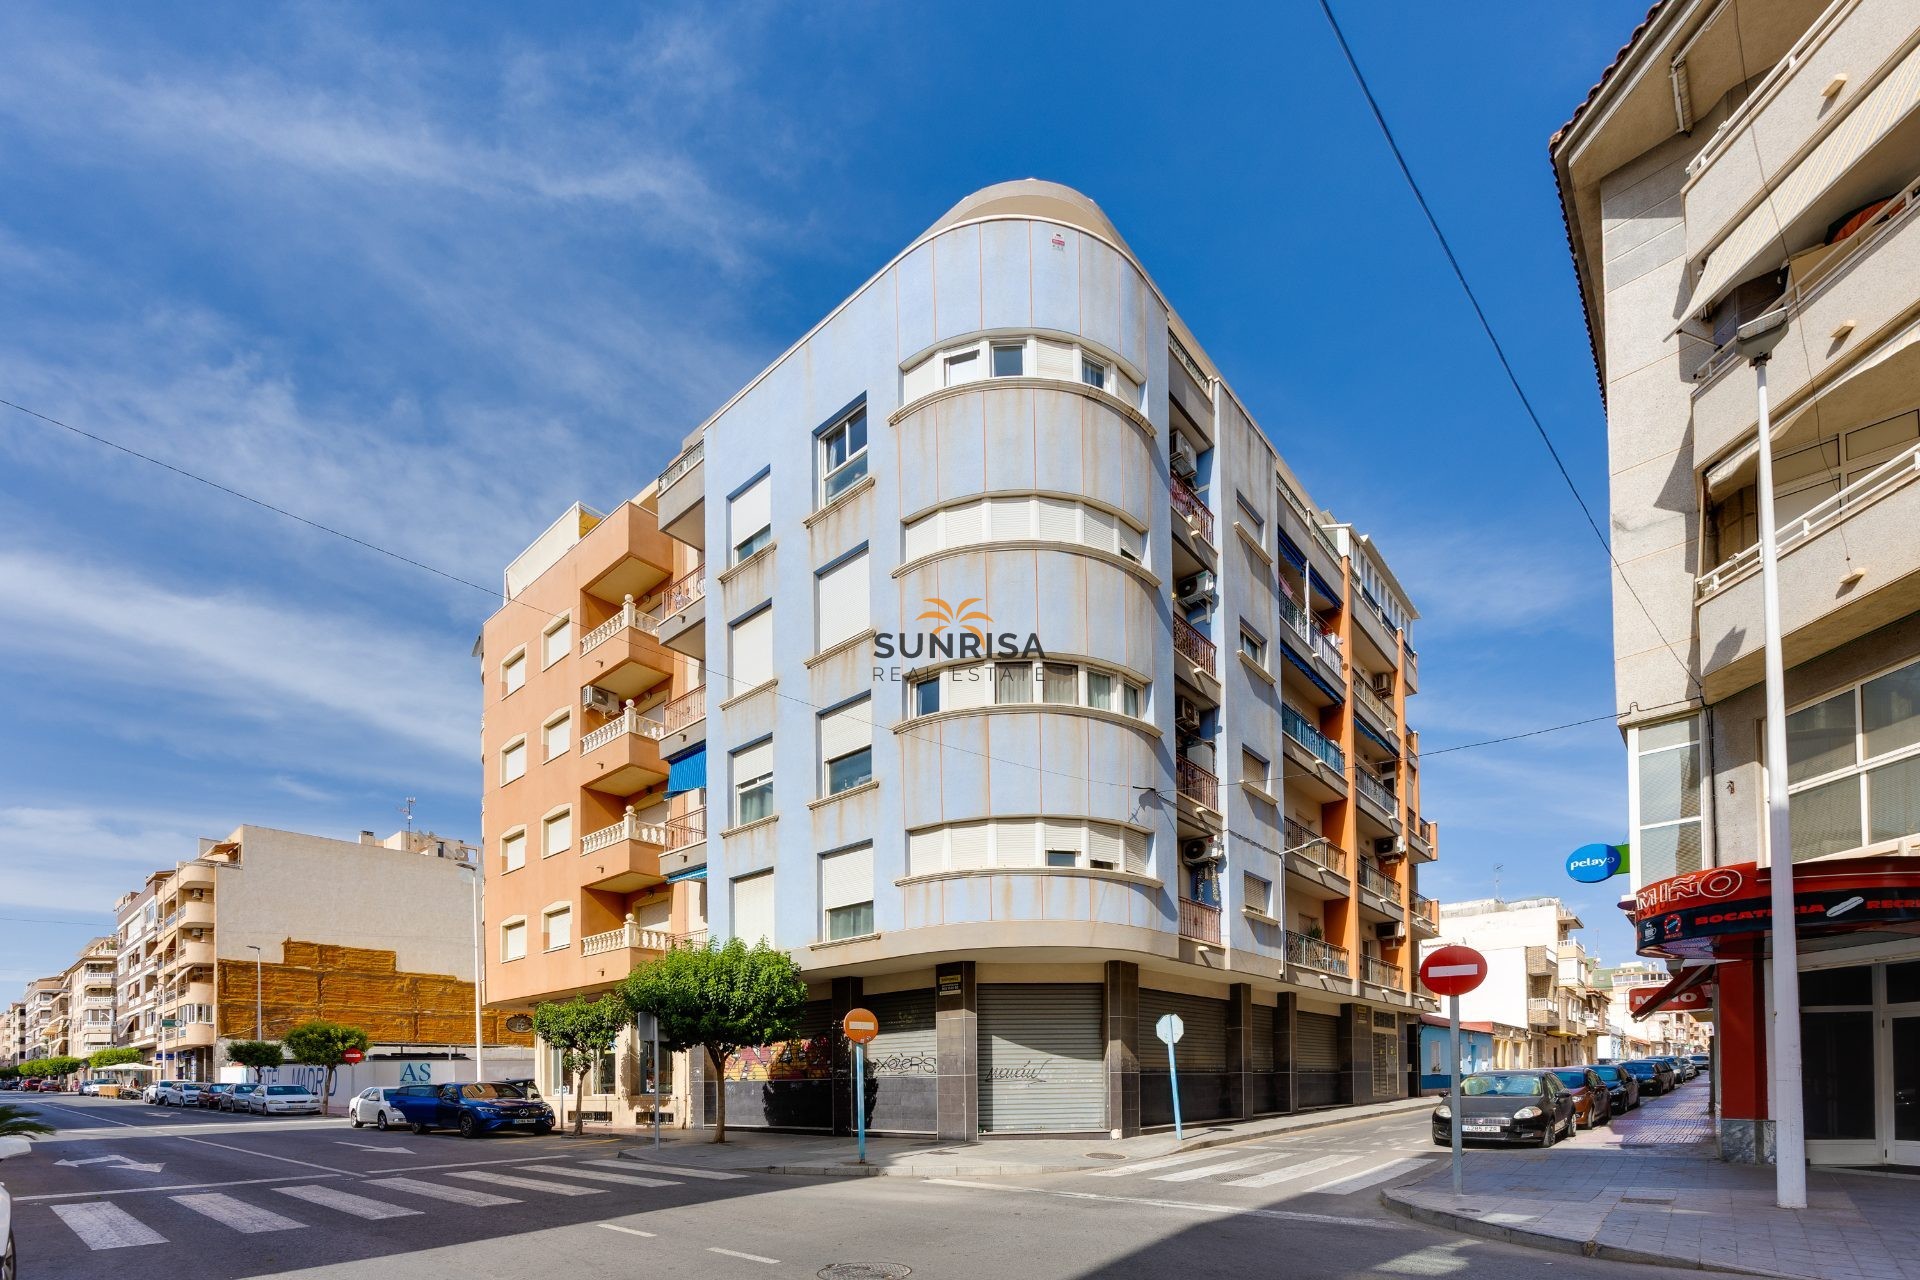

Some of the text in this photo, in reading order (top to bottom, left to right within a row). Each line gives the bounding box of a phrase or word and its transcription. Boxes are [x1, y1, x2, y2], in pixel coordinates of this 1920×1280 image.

[1570, 856, 1615, 871] pelayo
[1636, 868, 1743, 910] MIÑO
[1695, 903, 1825, 926] BOCATIA
[1635, 992, 1698, 1005] MO
[399, 1062, 431, 1082] AS
